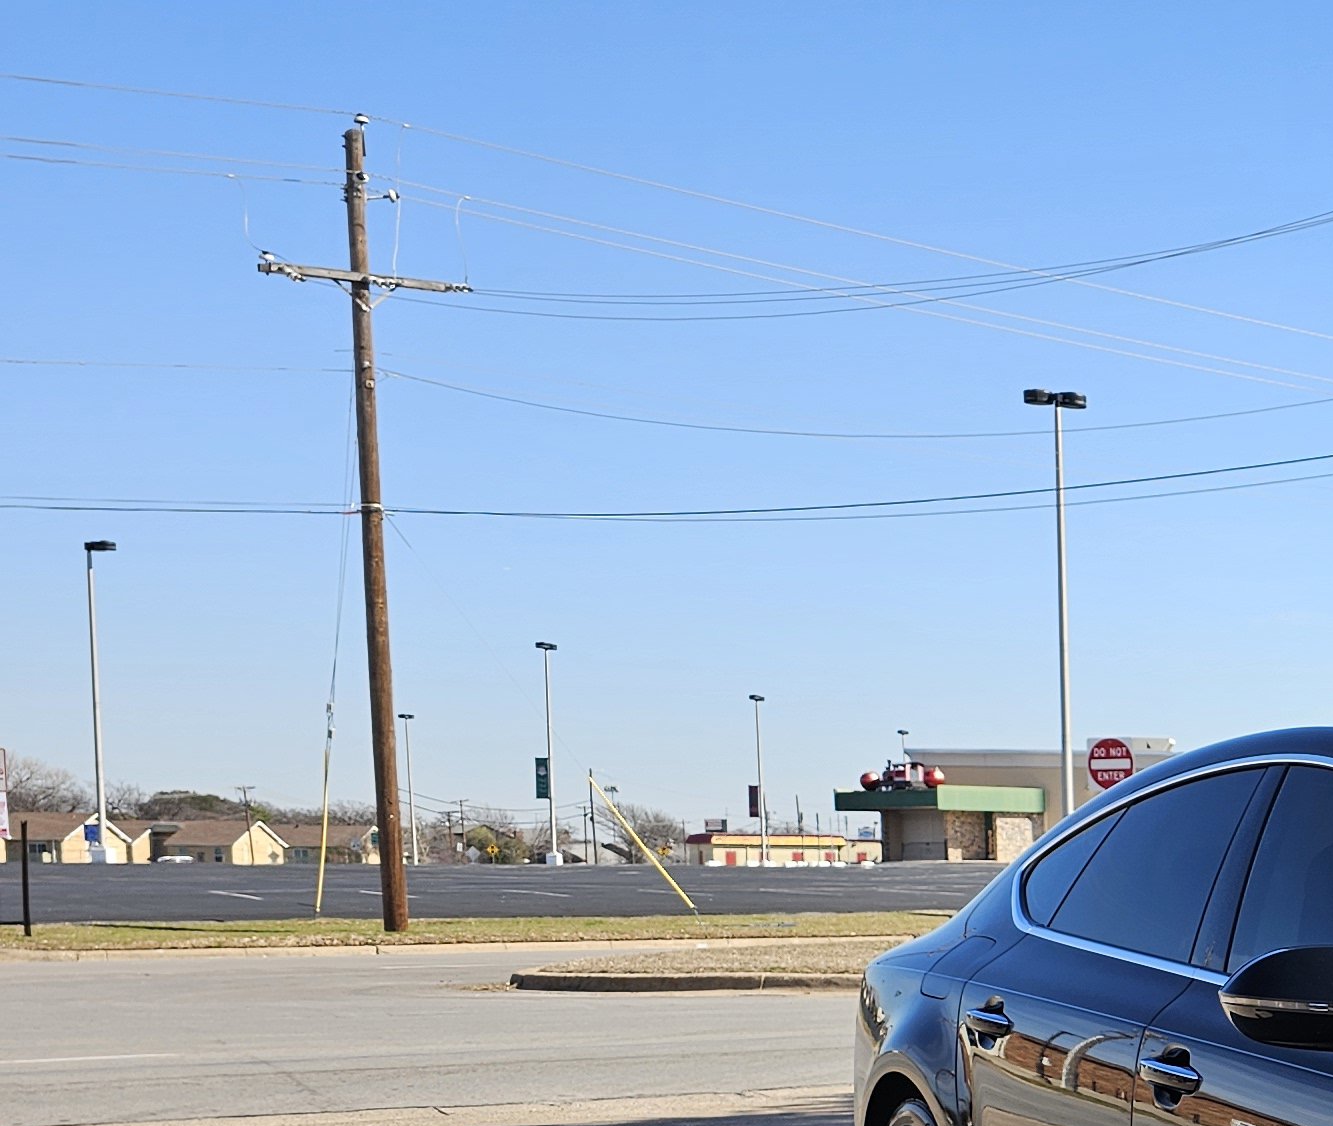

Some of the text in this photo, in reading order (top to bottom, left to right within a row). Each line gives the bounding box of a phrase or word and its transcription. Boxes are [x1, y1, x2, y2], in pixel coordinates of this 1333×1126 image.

[1093, 746, 1127, 758] DO NOT
[1097, 770, 1125, 781] ENTER
